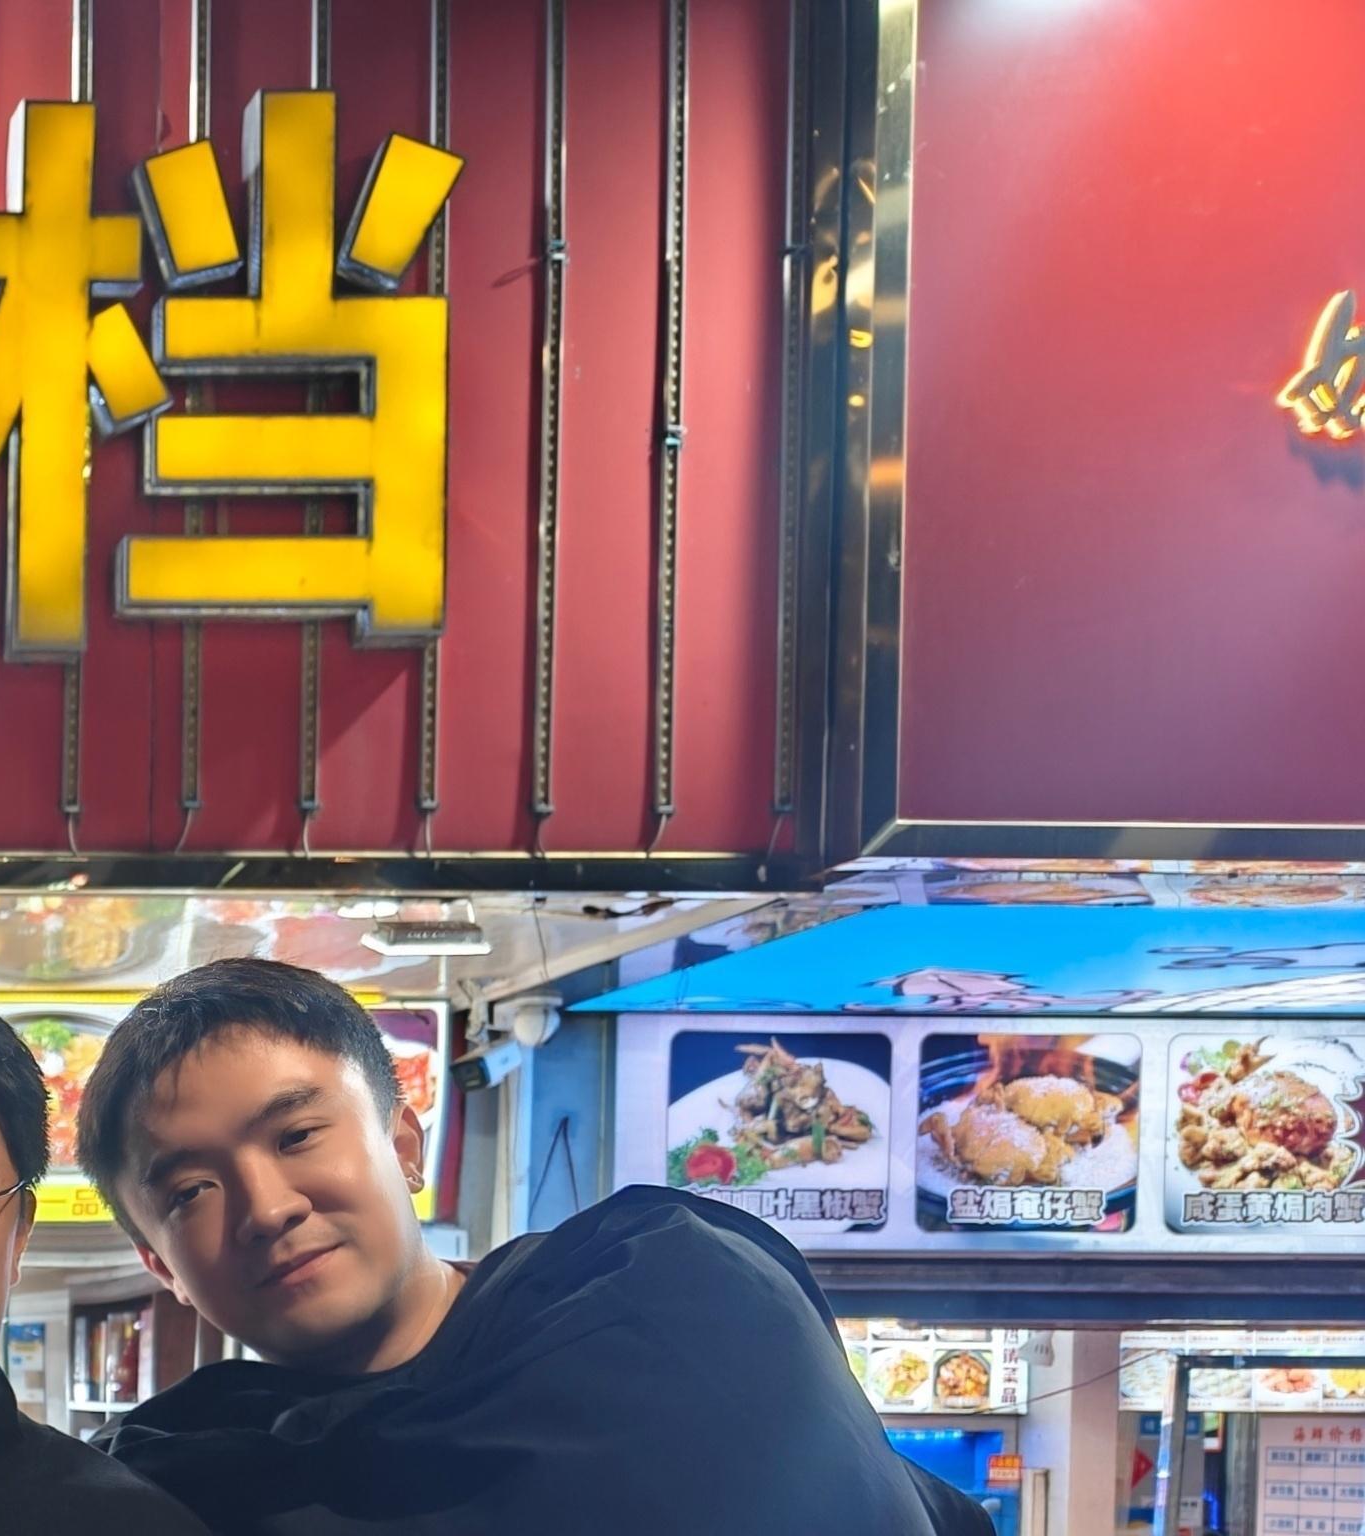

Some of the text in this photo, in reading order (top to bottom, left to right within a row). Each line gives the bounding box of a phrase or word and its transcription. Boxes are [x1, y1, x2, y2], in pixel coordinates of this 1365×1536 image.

[1183, 1190, 1364, 1223] 咸蛋黄焗肉蟹
